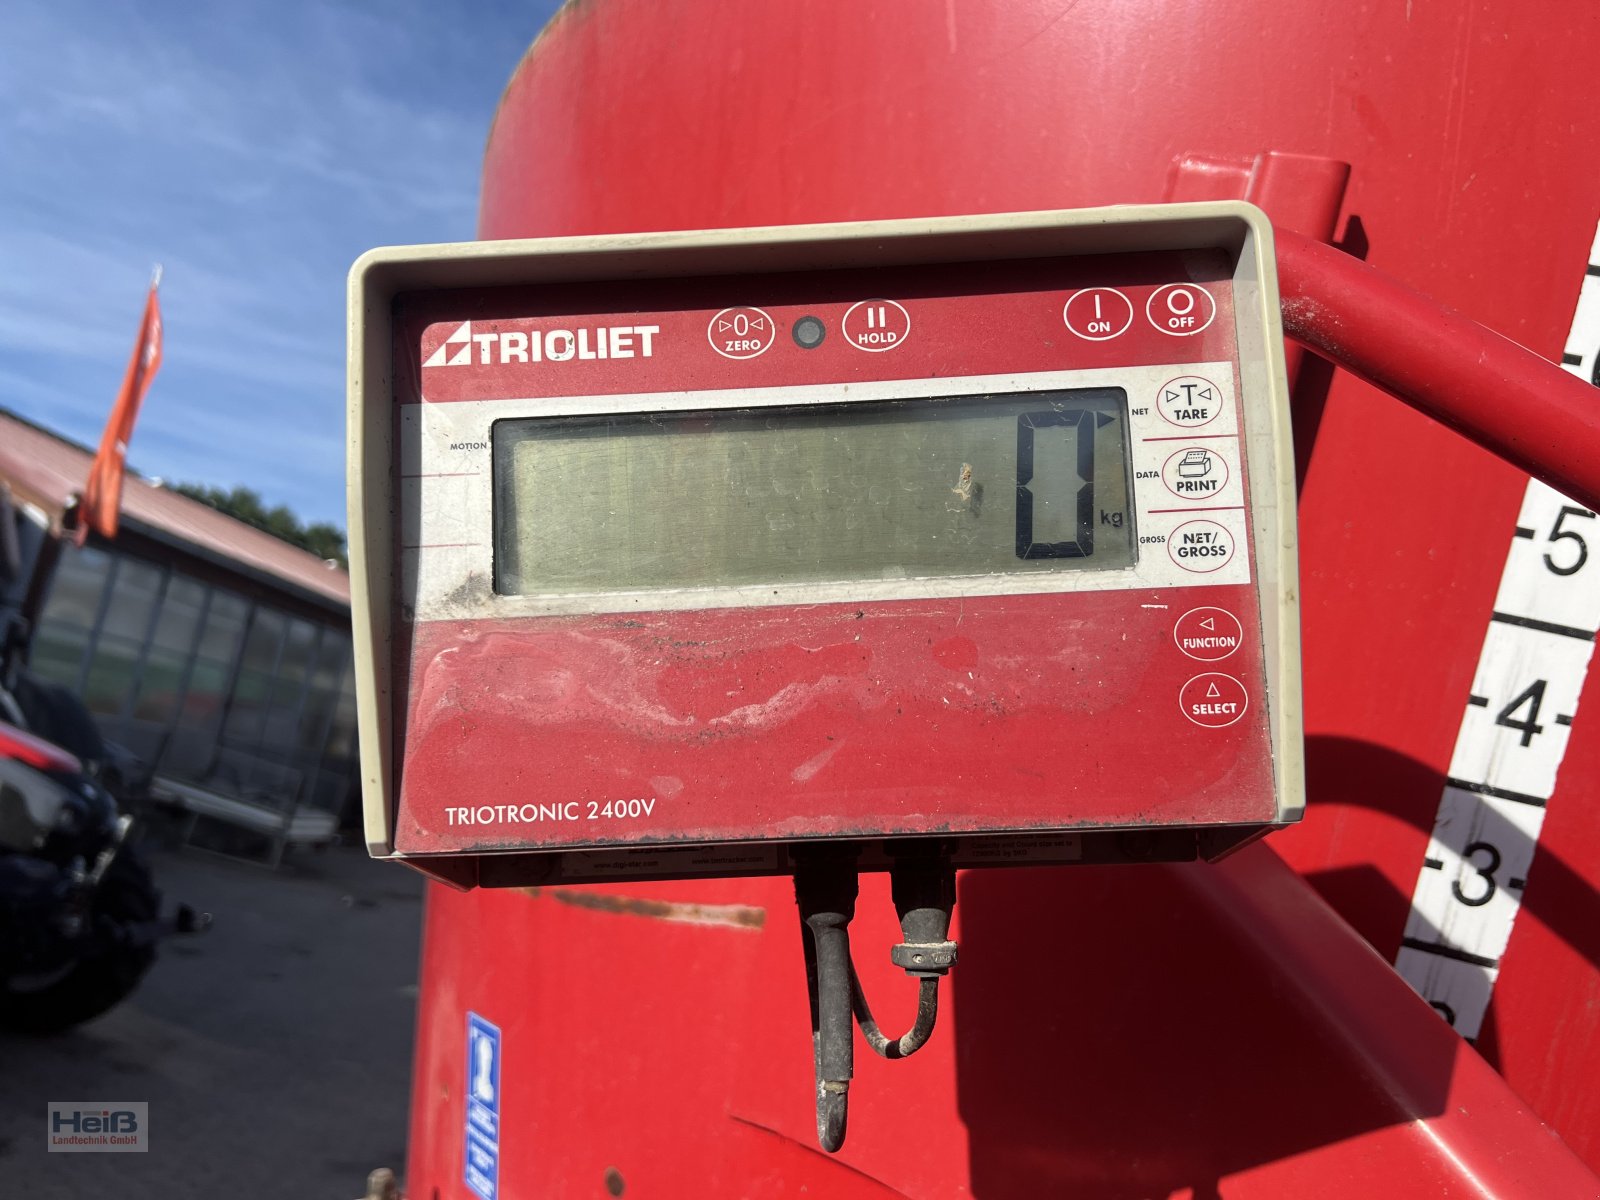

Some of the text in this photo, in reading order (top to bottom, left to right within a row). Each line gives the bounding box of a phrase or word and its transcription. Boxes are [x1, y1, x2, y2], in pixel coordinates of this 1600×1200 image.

[1087, 321, 1110, 333] ON
[1168, 316, 1195, 328] OFF
[858, 331, 897, 344] HOLD
[472, 325, 660, 365] TRIOLIET
[725, 339, 761, 352] ZERO
[1131, 408, 1149, 416] NET
[1174, 408, 1208, 420] TARE
[450, 442, 487, 451] MOTION
[1136, 471, 1160, 479] DATA
[1016, 409, 1123, 560] 0 kg
[1176, 479, 1218, 492] PRINT
[1140, 535, 1166, 544] GROSS
[1183, 531, 1218, 544] NET/
[1543, 505, 1597, 576] 5
[1177, 545, 1226, 558] GROSS
[1183, 636, 1236, 649] FUNCTION
[1192, 702, 1237, 715] SELECT
[1495, 679, 1548, 748] 4
[445, 798, 656, 826] TRIOTRONIC 2400V
[1451, 841, 1501, 907] 3
